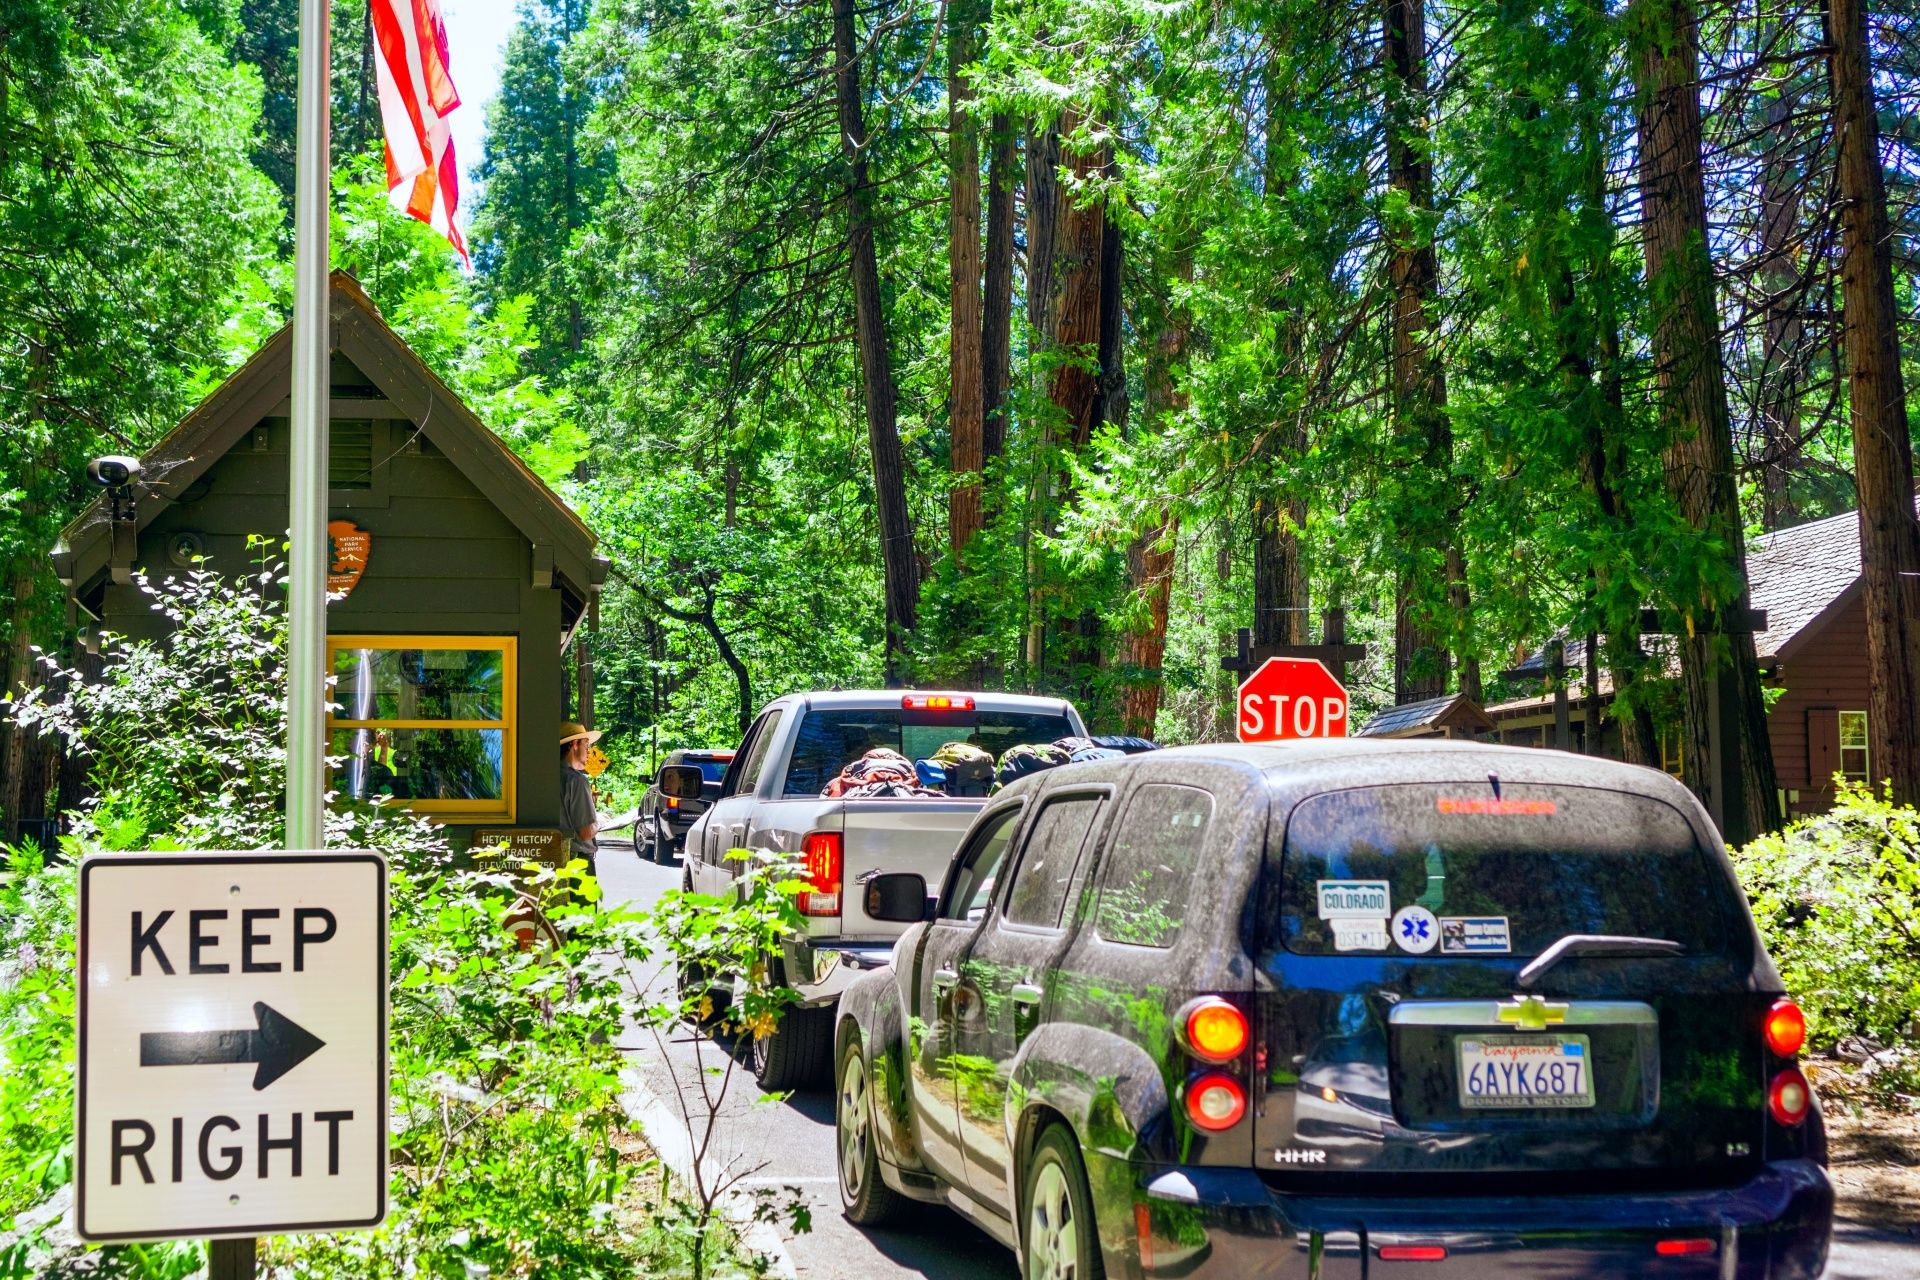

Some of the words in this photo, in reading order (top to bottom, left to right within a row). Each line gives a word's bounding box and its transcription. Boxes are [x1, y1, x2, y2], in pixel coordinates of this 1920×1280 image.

[1241, 693, 1345, 738] STOP
[482, 835, 512, 844] HETCH
[516, 835, 553, 844] HETCHY
[494, 848, 542, 857] NTRANCE
[478, 861, 522, 870] ELEVATIO
[1324, 893, 1385, 910] COLORADO
[130, 906, 337, 977] KEEP
[1483, 1045, 1563, 1061] California
[1468, 1062, 1581, 1096] 6AYK687
[110, 1110, 354, 1186] RIGHT
[1274, 1148, 1327, 1163] HHR
